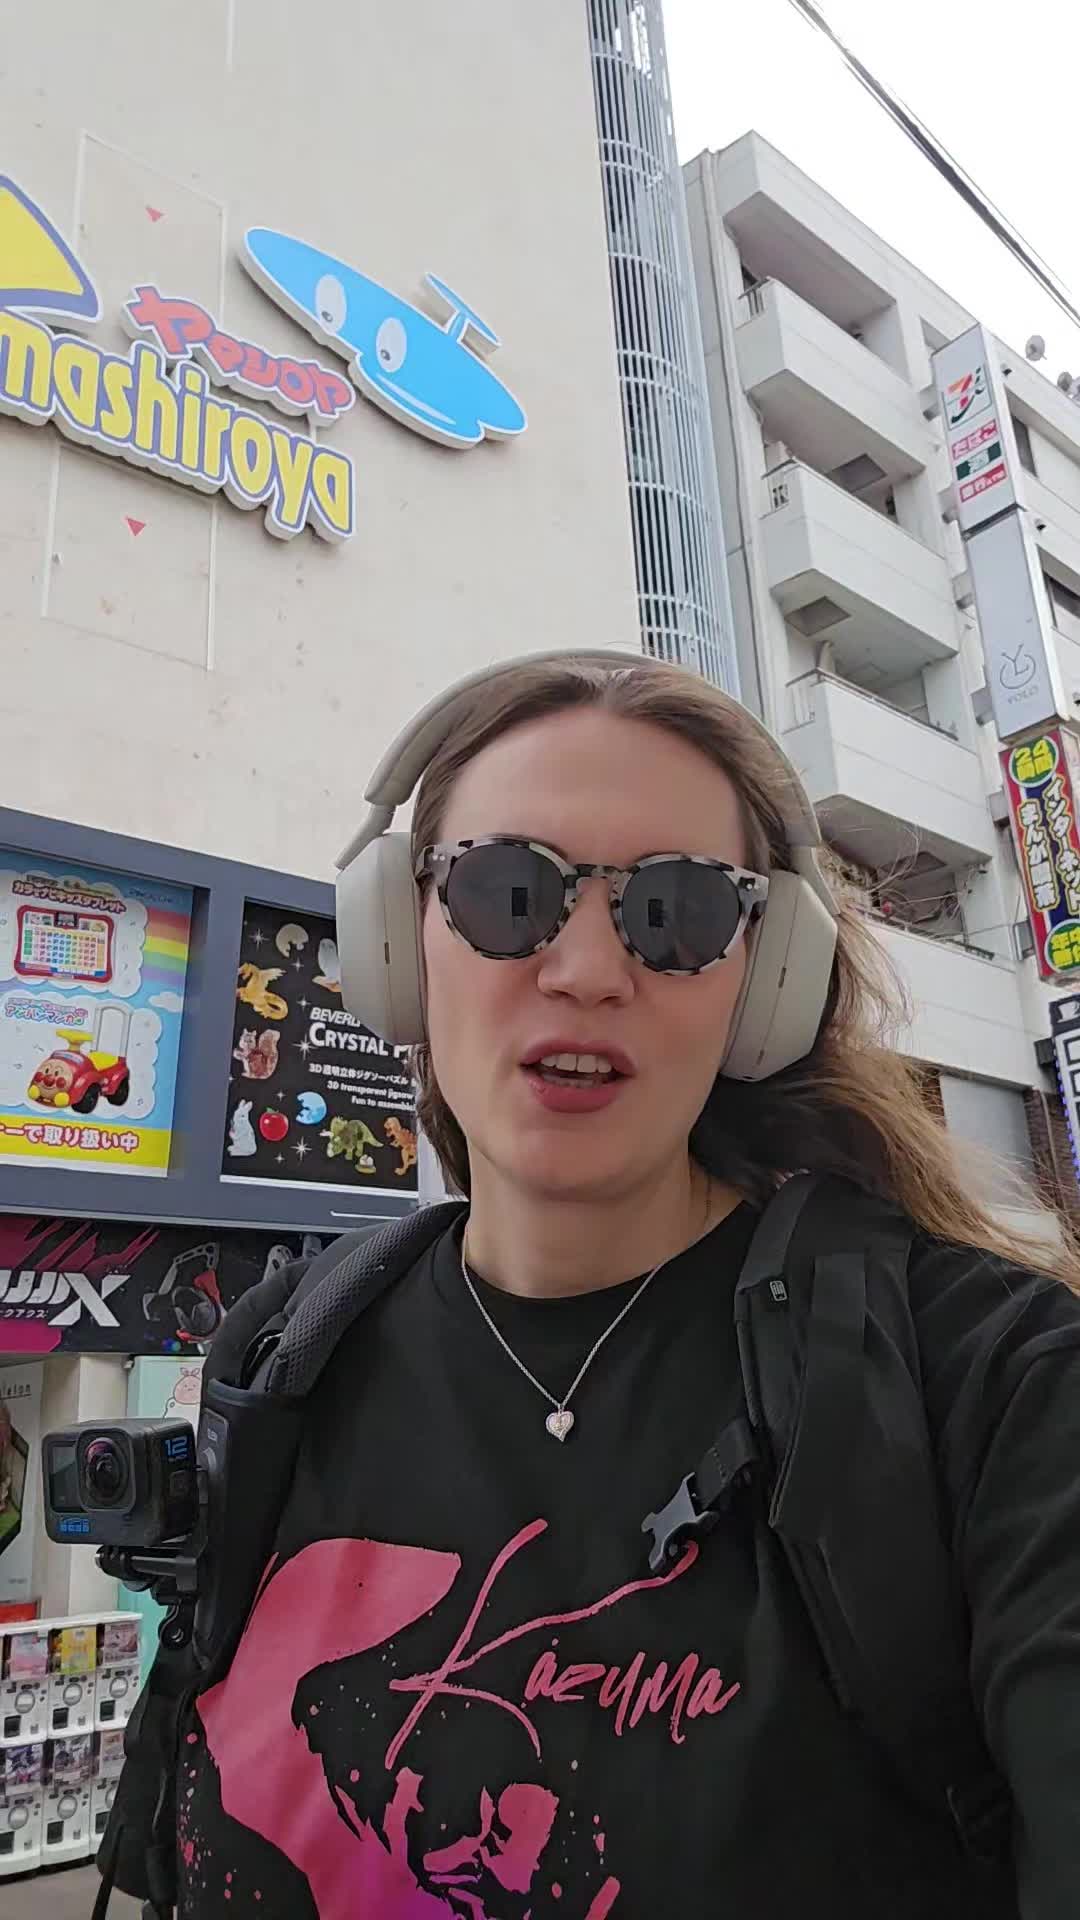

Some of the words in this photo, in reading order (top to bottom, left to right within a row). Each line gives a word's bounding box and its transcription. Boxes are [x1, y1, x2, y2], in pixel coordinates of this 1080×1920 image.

[310, 1007, 361, 1027] BEVERL
[0, 1123, 139, 1152] ーで取り扱い中
[165, 1435, 188, 1457] 12
